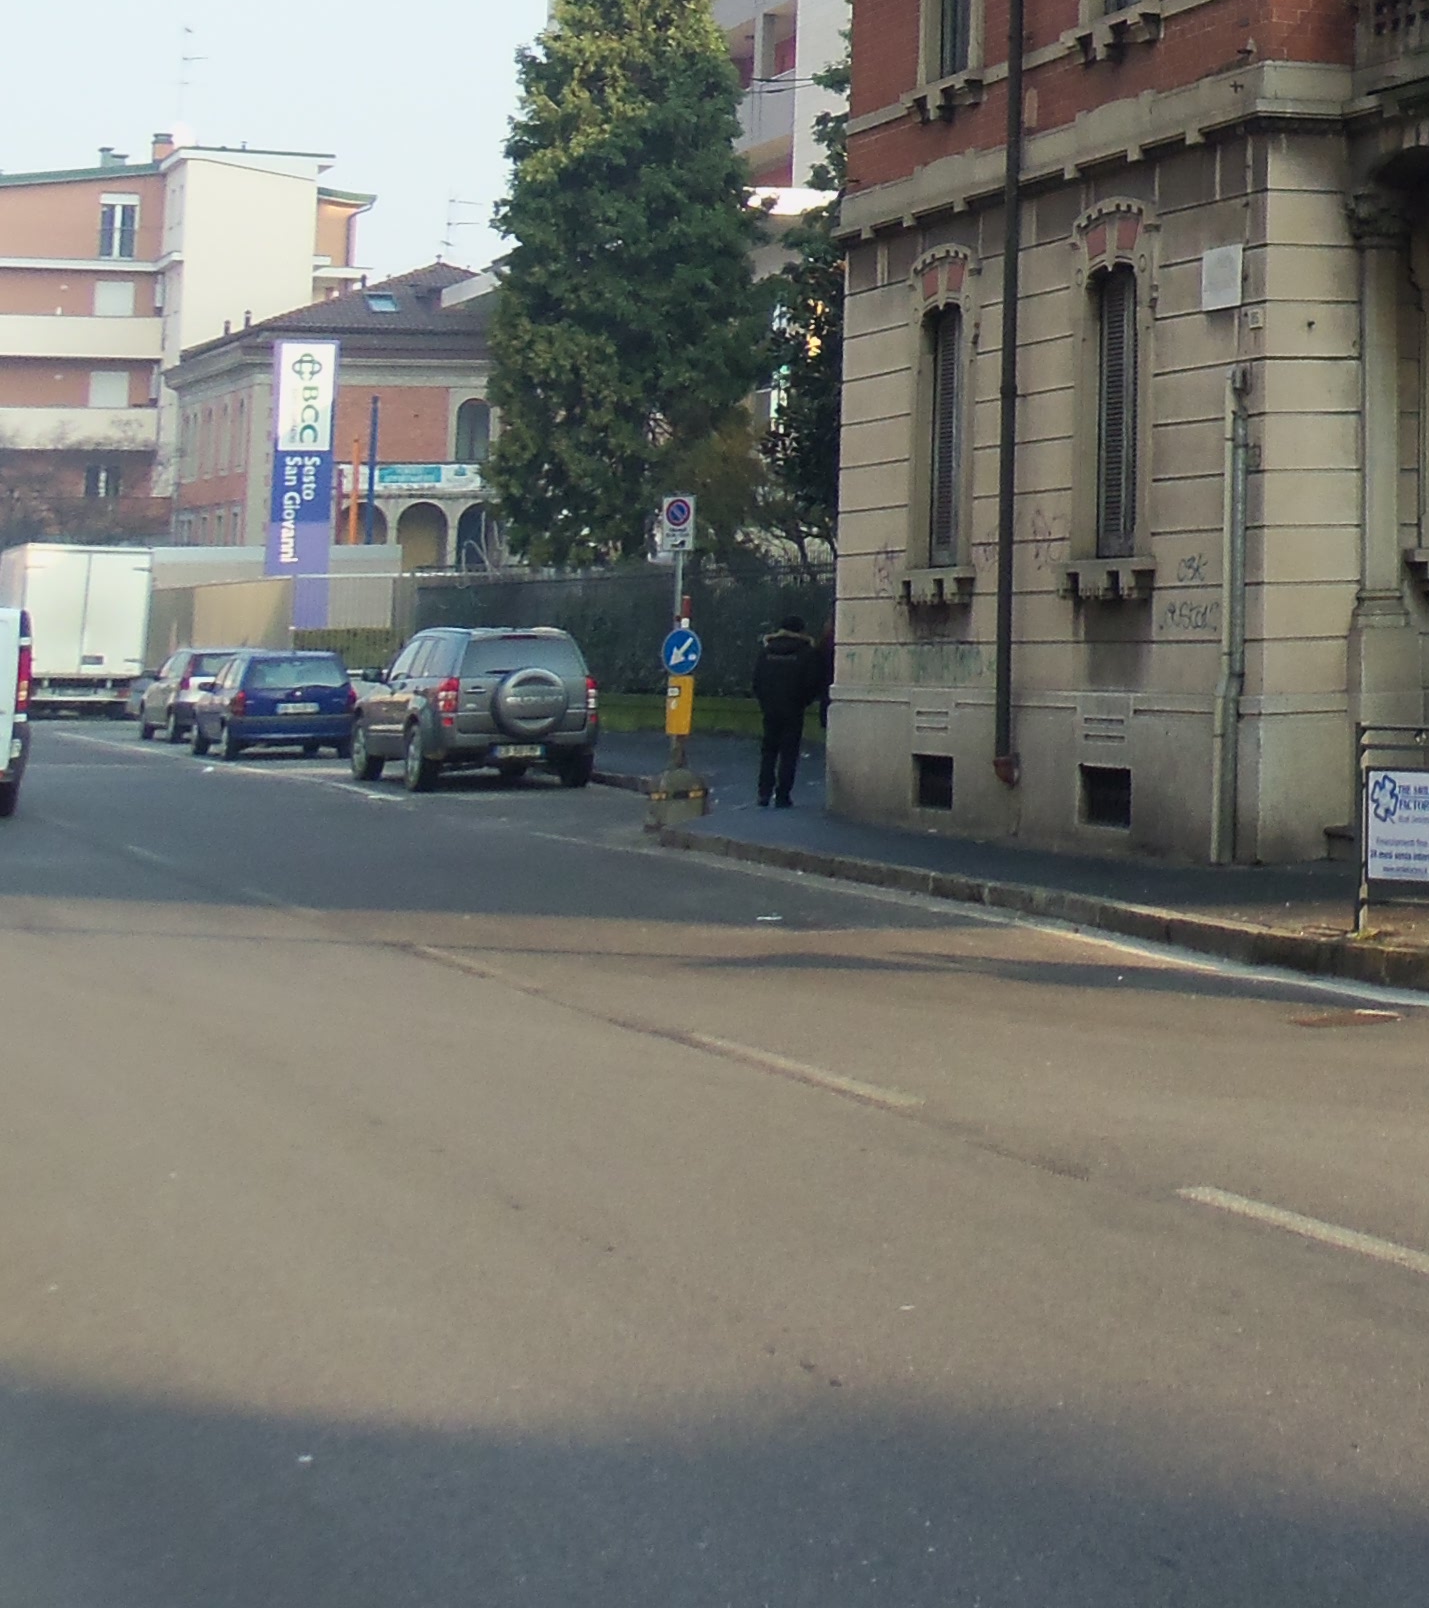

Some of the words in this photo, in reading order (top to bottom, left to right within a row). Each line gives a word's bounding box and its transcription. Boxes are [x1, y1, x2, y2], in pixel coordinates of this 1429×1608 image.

[299, 386, 320, 443] BCC
[284, 456, 302, 486] San
[302, 456, 320, 501] Sesto
[280, 493, 301, 563] Giovanni
